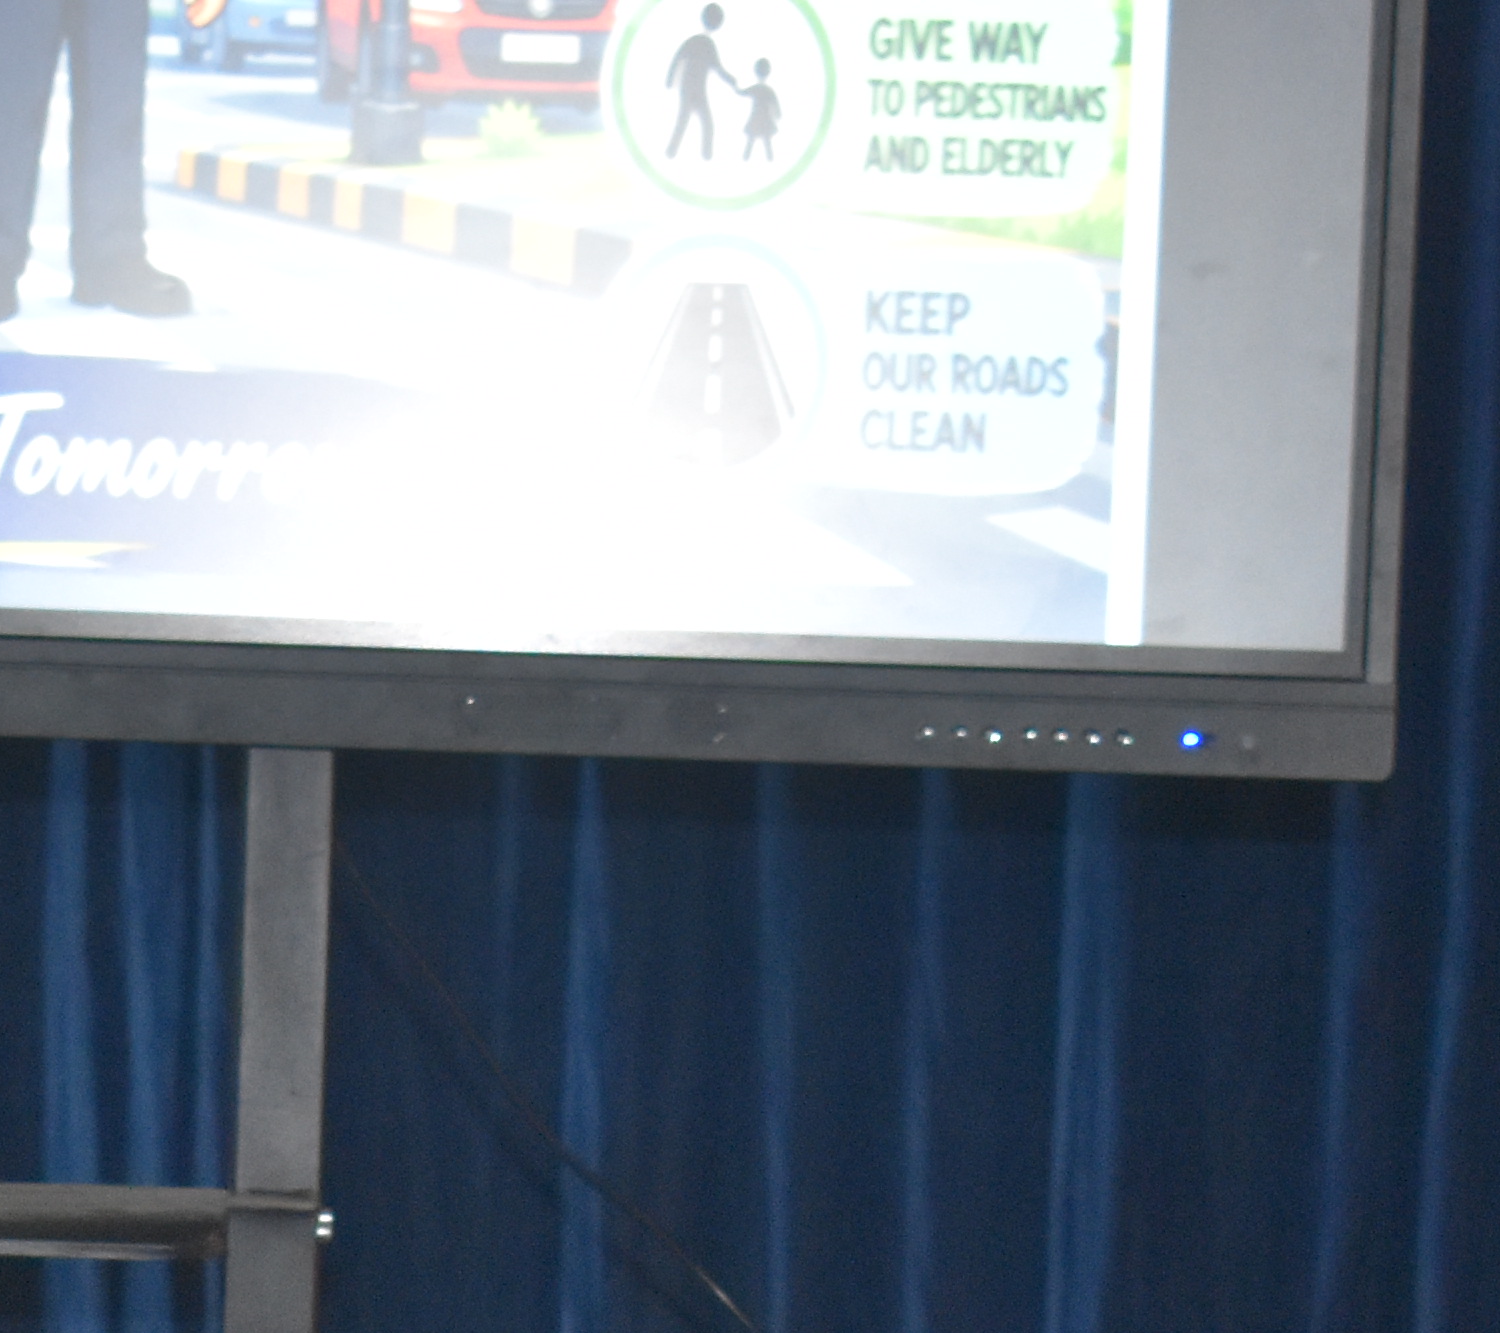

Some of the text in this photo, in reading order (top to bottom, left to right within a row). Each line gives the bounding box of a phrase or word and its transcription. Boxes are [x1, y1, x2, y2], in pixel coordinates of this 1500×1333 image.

[869, 17, 1048, 64] GIVE WAY
[868, 79, 1107, 122] TO PEDESTRIANS
[864, 134, 1074, 178] AND ELDERLY
[866, 290, 971, 335] KEEP
[863, 351, 1069, 398] OUR ROADS
[861, 408, 986, 453] CLEAN
